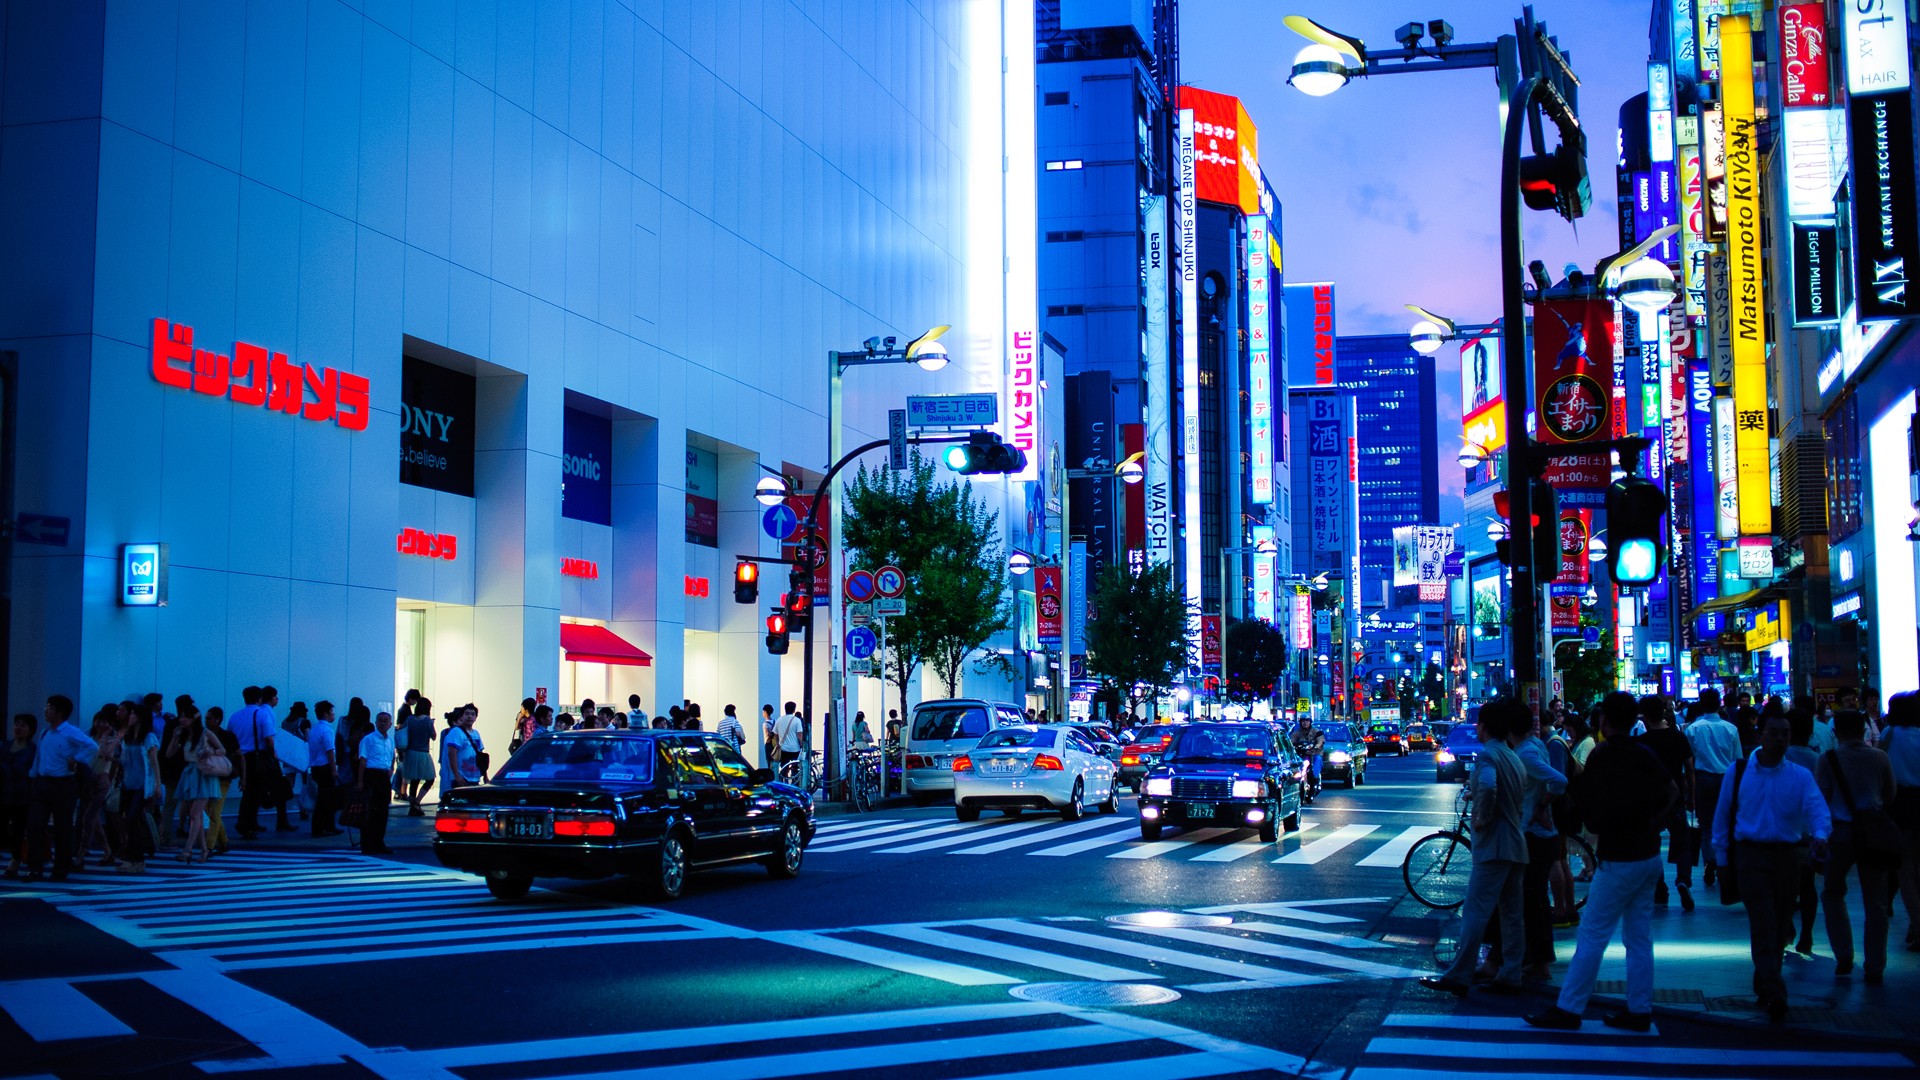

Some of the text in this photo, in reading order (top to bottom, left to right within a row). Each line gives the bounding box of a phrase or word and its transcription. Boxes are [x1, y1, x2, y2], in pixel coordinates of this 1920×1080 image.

[1784, 9, 1805, 103] Ginza Calla
[1862, 71, 1897, 85] HAIR
[1875, 101, 1889, 179] EXCHANGE
[1640, 178, 1649, 211] MIZUHO
[1660, 171, 1669, 203] MIZUHO
[1182, 137, 1194, 281] MEGANE TOP SHINJUKU
[1881, 186, 1894, 247] ARMANI
[1738, 206, 1758, 341] Matsumoto
[1713, 255, 1732, 383] みずのクリニック
[149, 317, 370, 431] ビックカメラ
[1014, 331, 1033, 451] ビックカメラ
[1557, 381, 1580, 395] 新宿
[1693, 371, 1710, 412] AOKI
[911, 401, 989, 413] 新宿三丁目西
[1315, 400, 1335, 418] B1
[1548, 394, 1602, 414] エイサー
[927, 414, 956, 423] Shinjuku
[1561, 413, 1596, 433] まつり
[1739, 410, 1764, 431] 薬
[1313, 424, 1338, 452] 酒
[563, 453, 600, 481] sonic
[1091, 422, 1105, 515] UNIVRSAL
[1548, 456, 1606, 467] 月28日(土)
[1419, 529, 1452, 550] カラオケ
[1433, 551, 1440, 561] の
[1742, 550, 1770, 559] ネイル
[1742, 561, 1770, 570] サロン
[1074, 601, 1082, 644] SHIRAISHI
[852, 635, 864, 656] P
[860, 646, 870, 655] 40
[514, 824, 542, 836] 18-03
